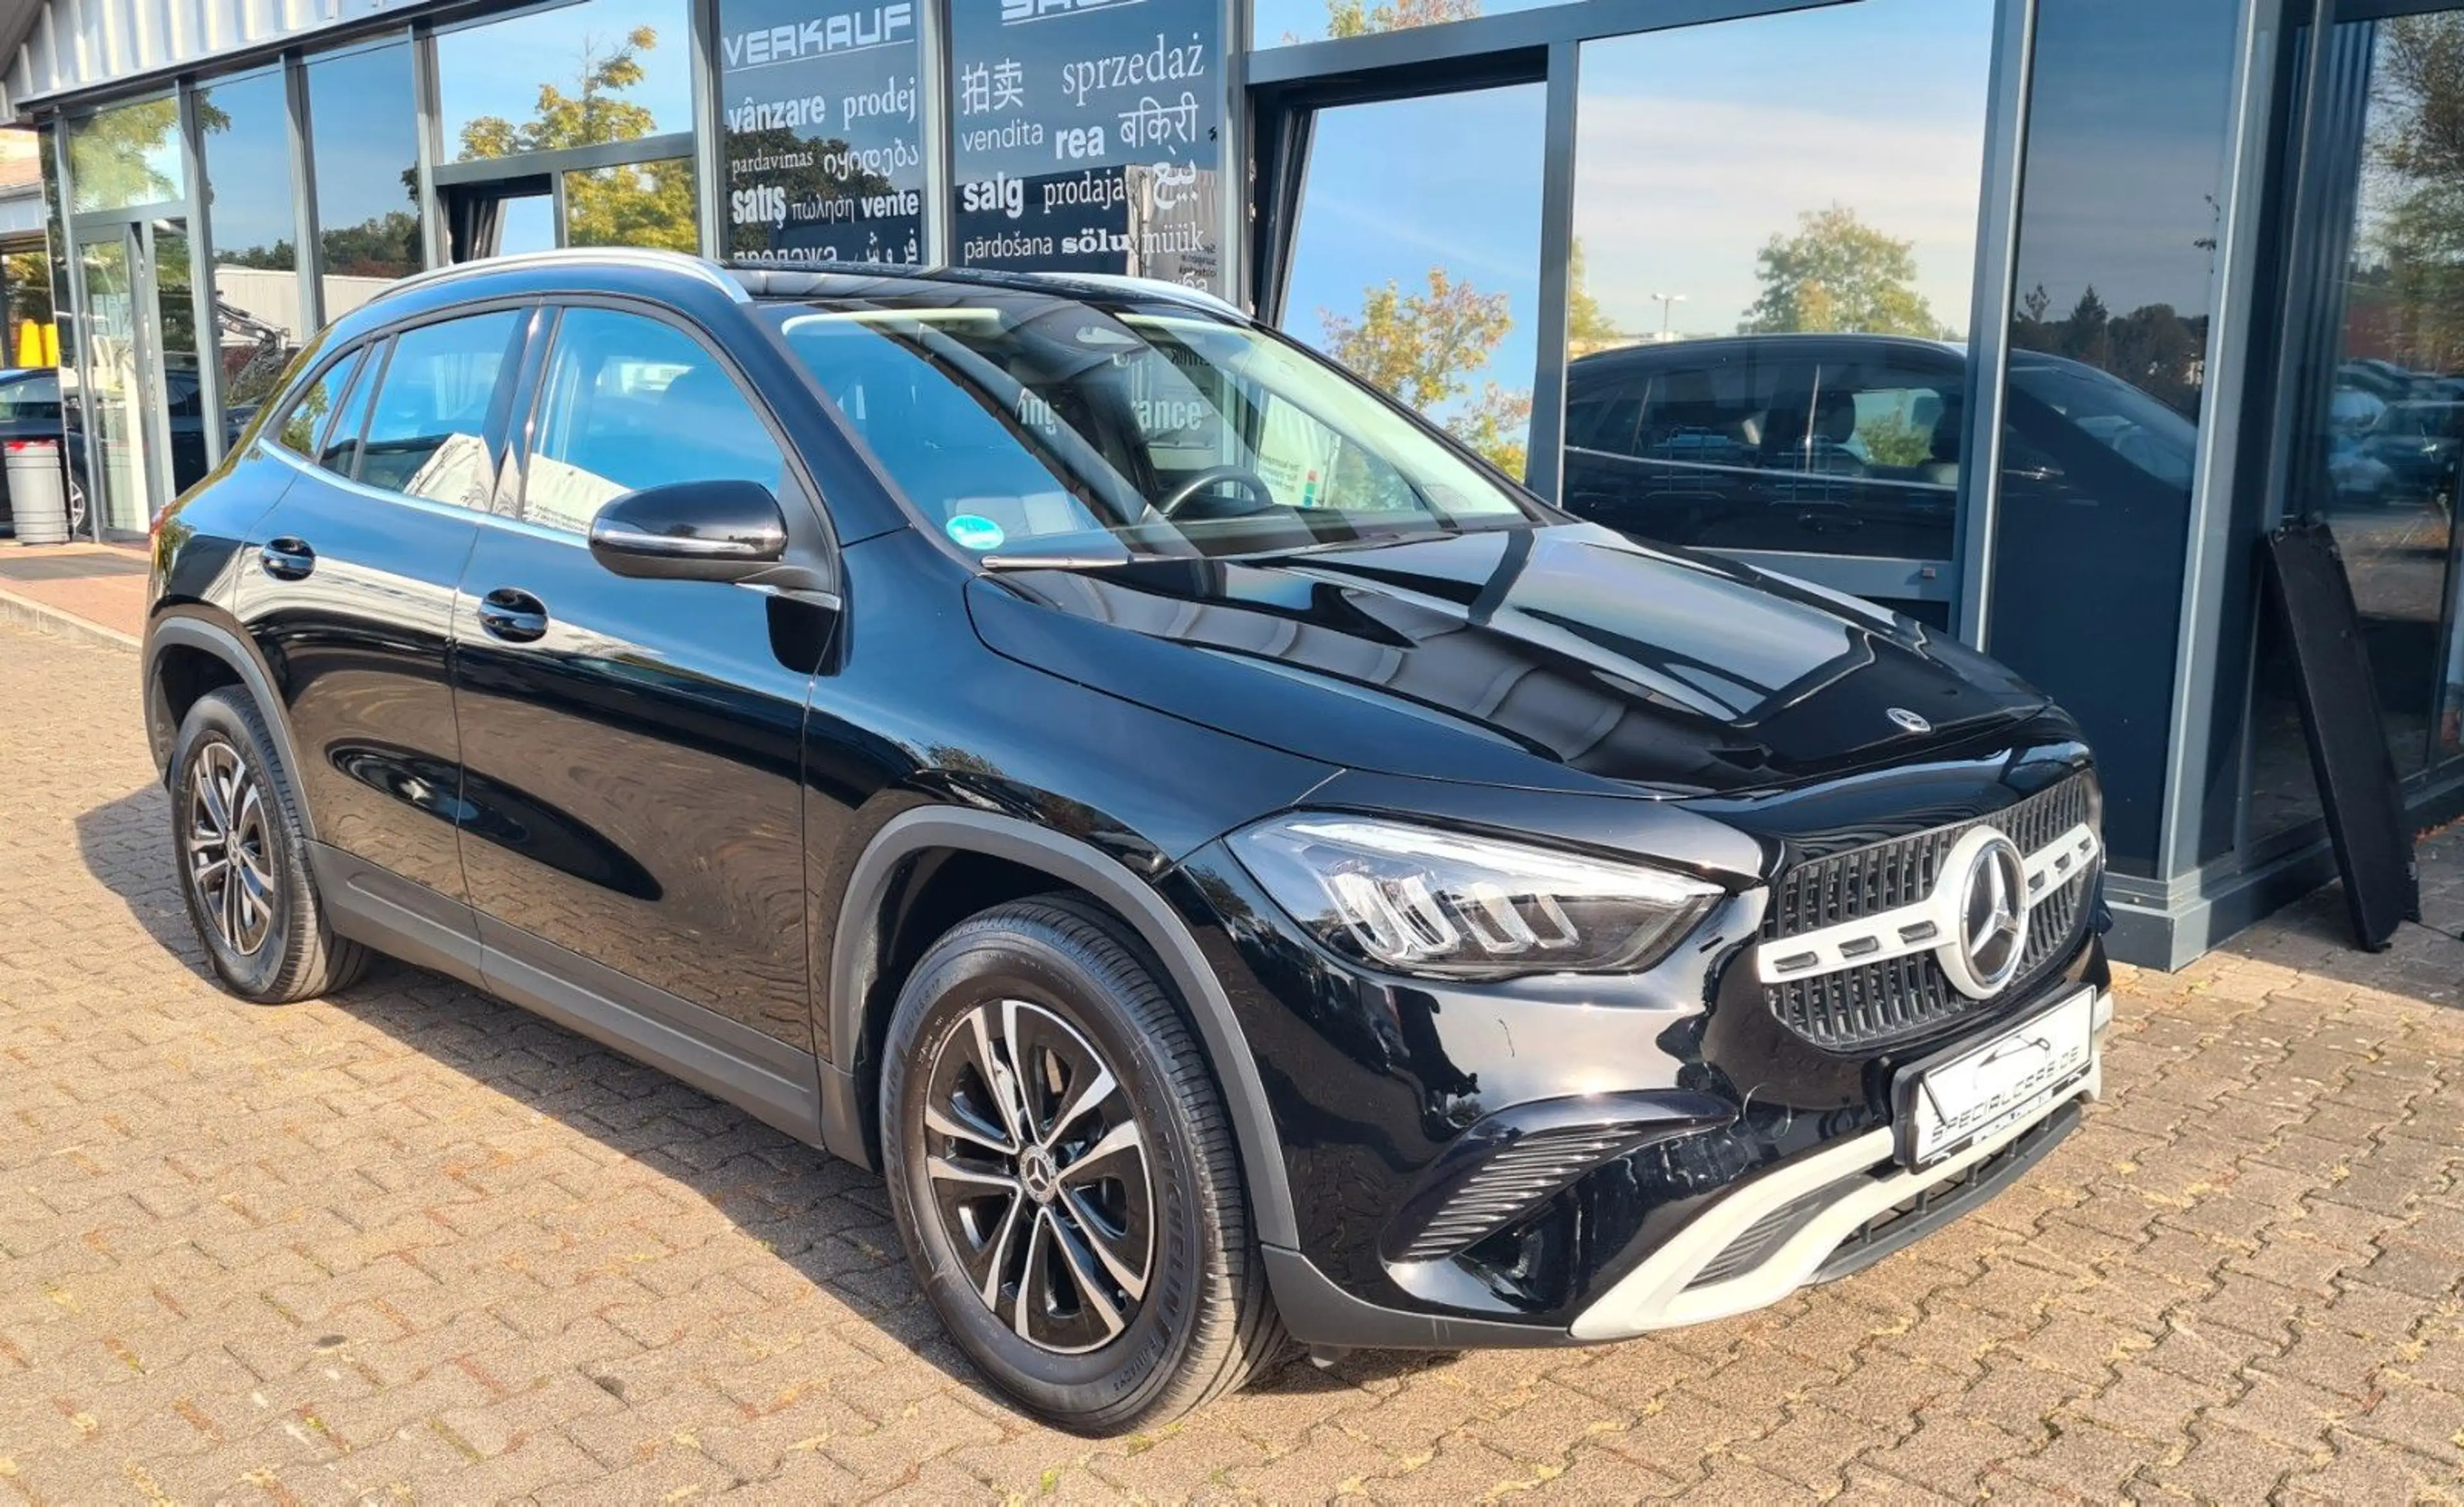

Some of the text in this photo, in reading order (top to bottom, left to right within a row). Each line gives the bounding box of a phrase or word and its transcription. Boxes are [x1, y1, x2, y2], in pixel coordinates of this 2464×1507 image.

[723, 2, 912, 67] VERKAUF
[962, 58, 1024, 115] 拍卖
[1062, 32, 1204, 107] sprzedaż
[728, 76, 916, 134] vânzare prodej
[963, 118, 1105, 160] vendita rea
[732, 148, 814, 180] pardavimas
[732, 183, 787, 230] satış
[860, 192, 920, 219] vente
[963, 169, 1125, 219] salg prodaja
[964, 221, 1204, 266] pārdošana sölu müük
